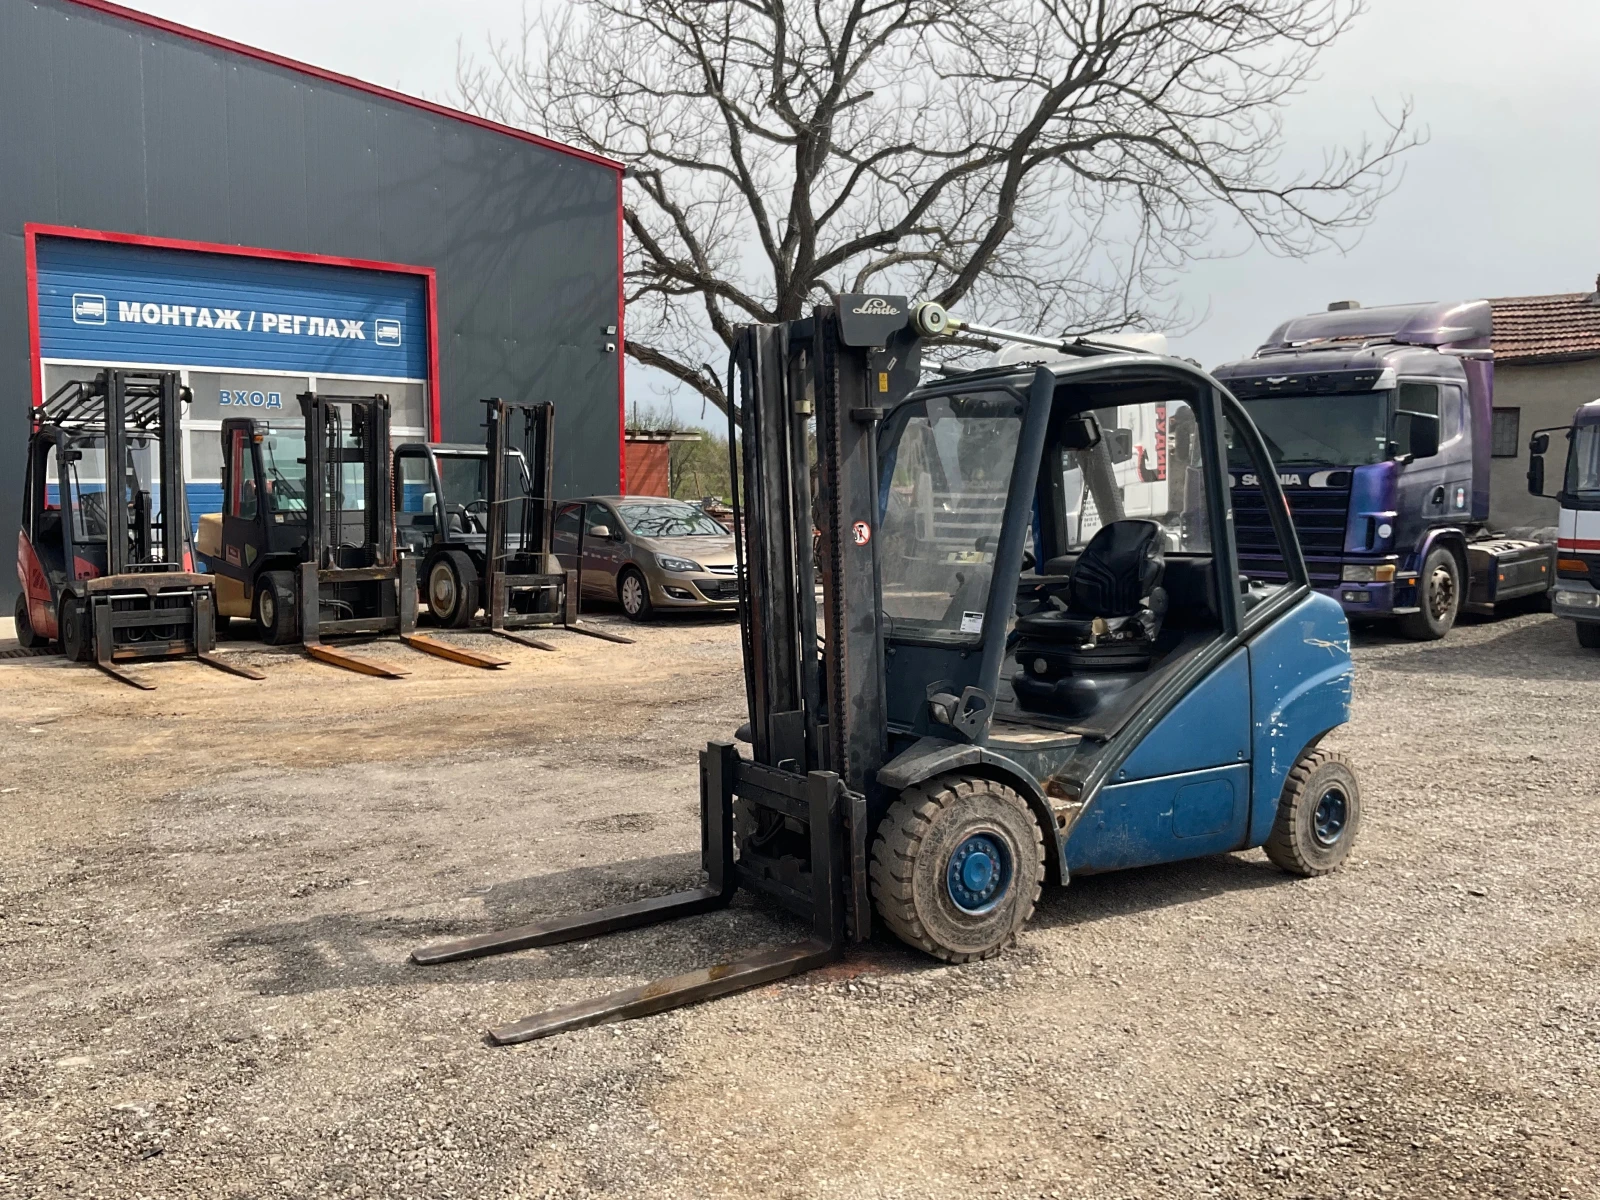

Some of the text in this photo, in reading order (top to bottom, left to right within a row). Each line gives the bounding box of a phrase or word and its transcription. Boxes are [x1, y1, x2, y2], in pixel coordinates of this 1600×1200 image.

[852, 297, 901, 315] Linde
[118, 300, 366, 340] МОНТАЖ / РЕГЛАЖ
[219, 389, 283, 410] ВХОД
